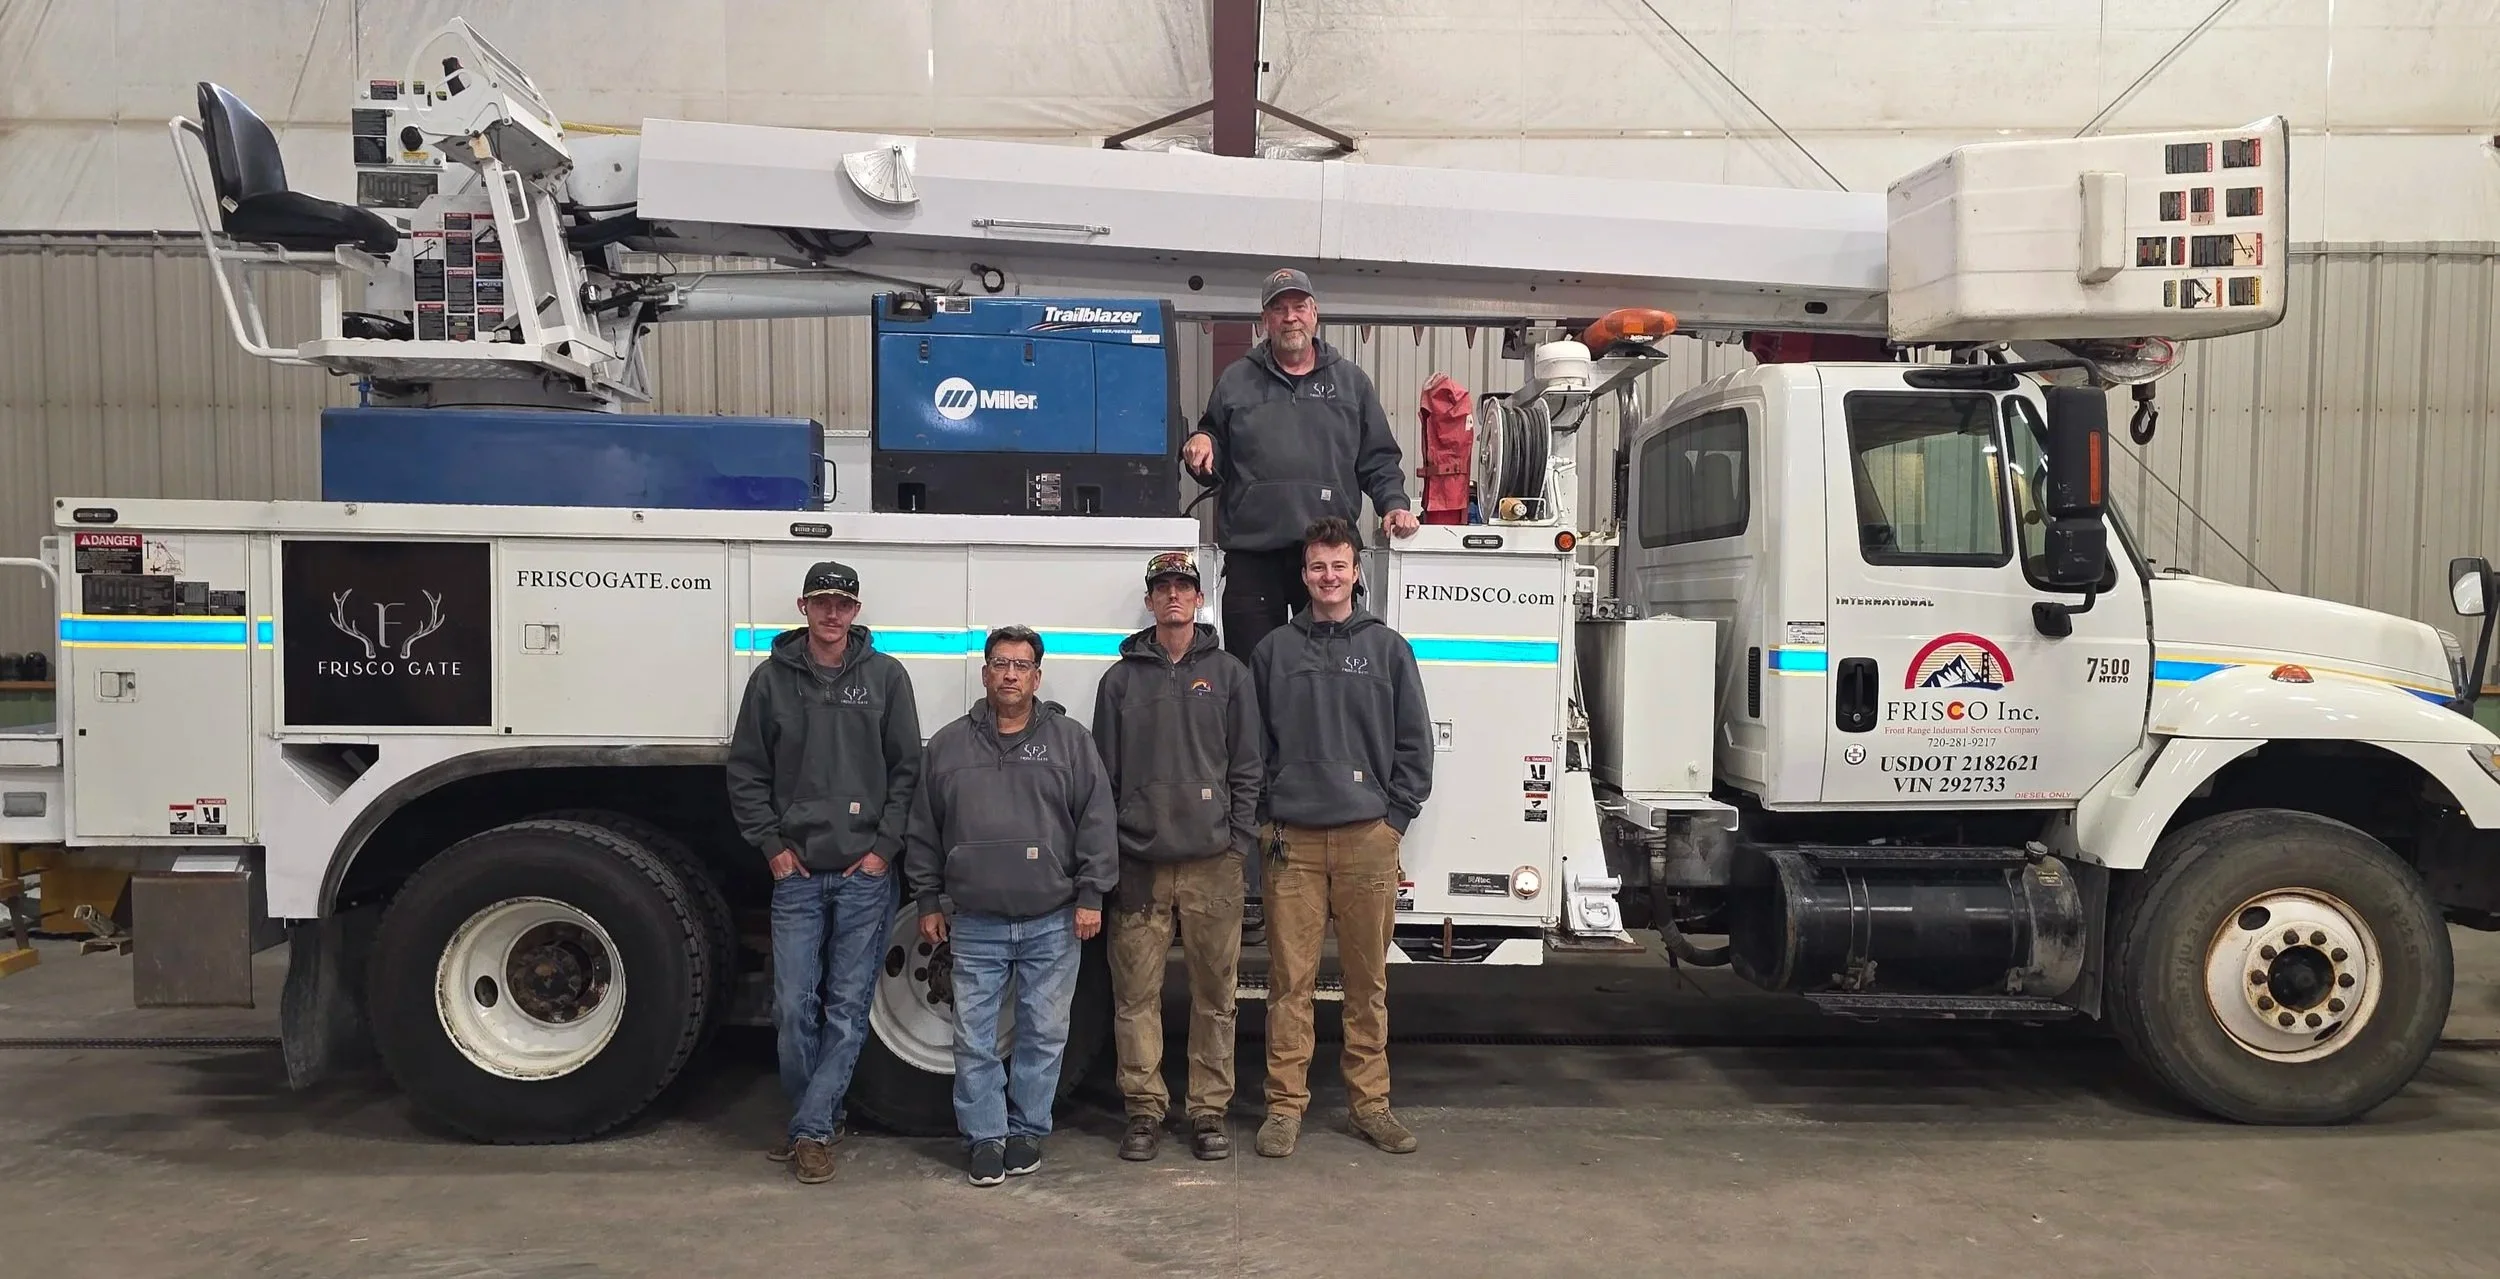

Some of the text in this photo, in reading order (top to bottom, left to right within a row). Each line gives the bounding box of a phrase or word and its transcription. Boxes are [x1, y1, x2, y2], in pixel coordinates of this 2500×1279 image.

[1045, 306, 1141, 324] Trailblazer
[91, 535, 137, 546] DANGER
[516, 570, 712, 590] FRISCOGATE.com
[1404, 584, 1555, 606] FRINDSCO.com
[1836, 597, 1934, 607] INTERNATIONAL
[373, 602, 405, 648] F
[318, 661, 461, 678] FRISCO GATE
[2087, 657, 2130, 682] 7500
[2099, 675, 2129, 683] HT570
[1886, 701, 2040, 721] FRISCO Inc.
[1885, 726, 2040, 737] Front Range Industrial Services Company
[1928, 738, 1996, 748] 720-281-9217
[1880, 755, 2038, 772] USDOT 2182621
[1893, 777, 2006, 793] VIN 292733
